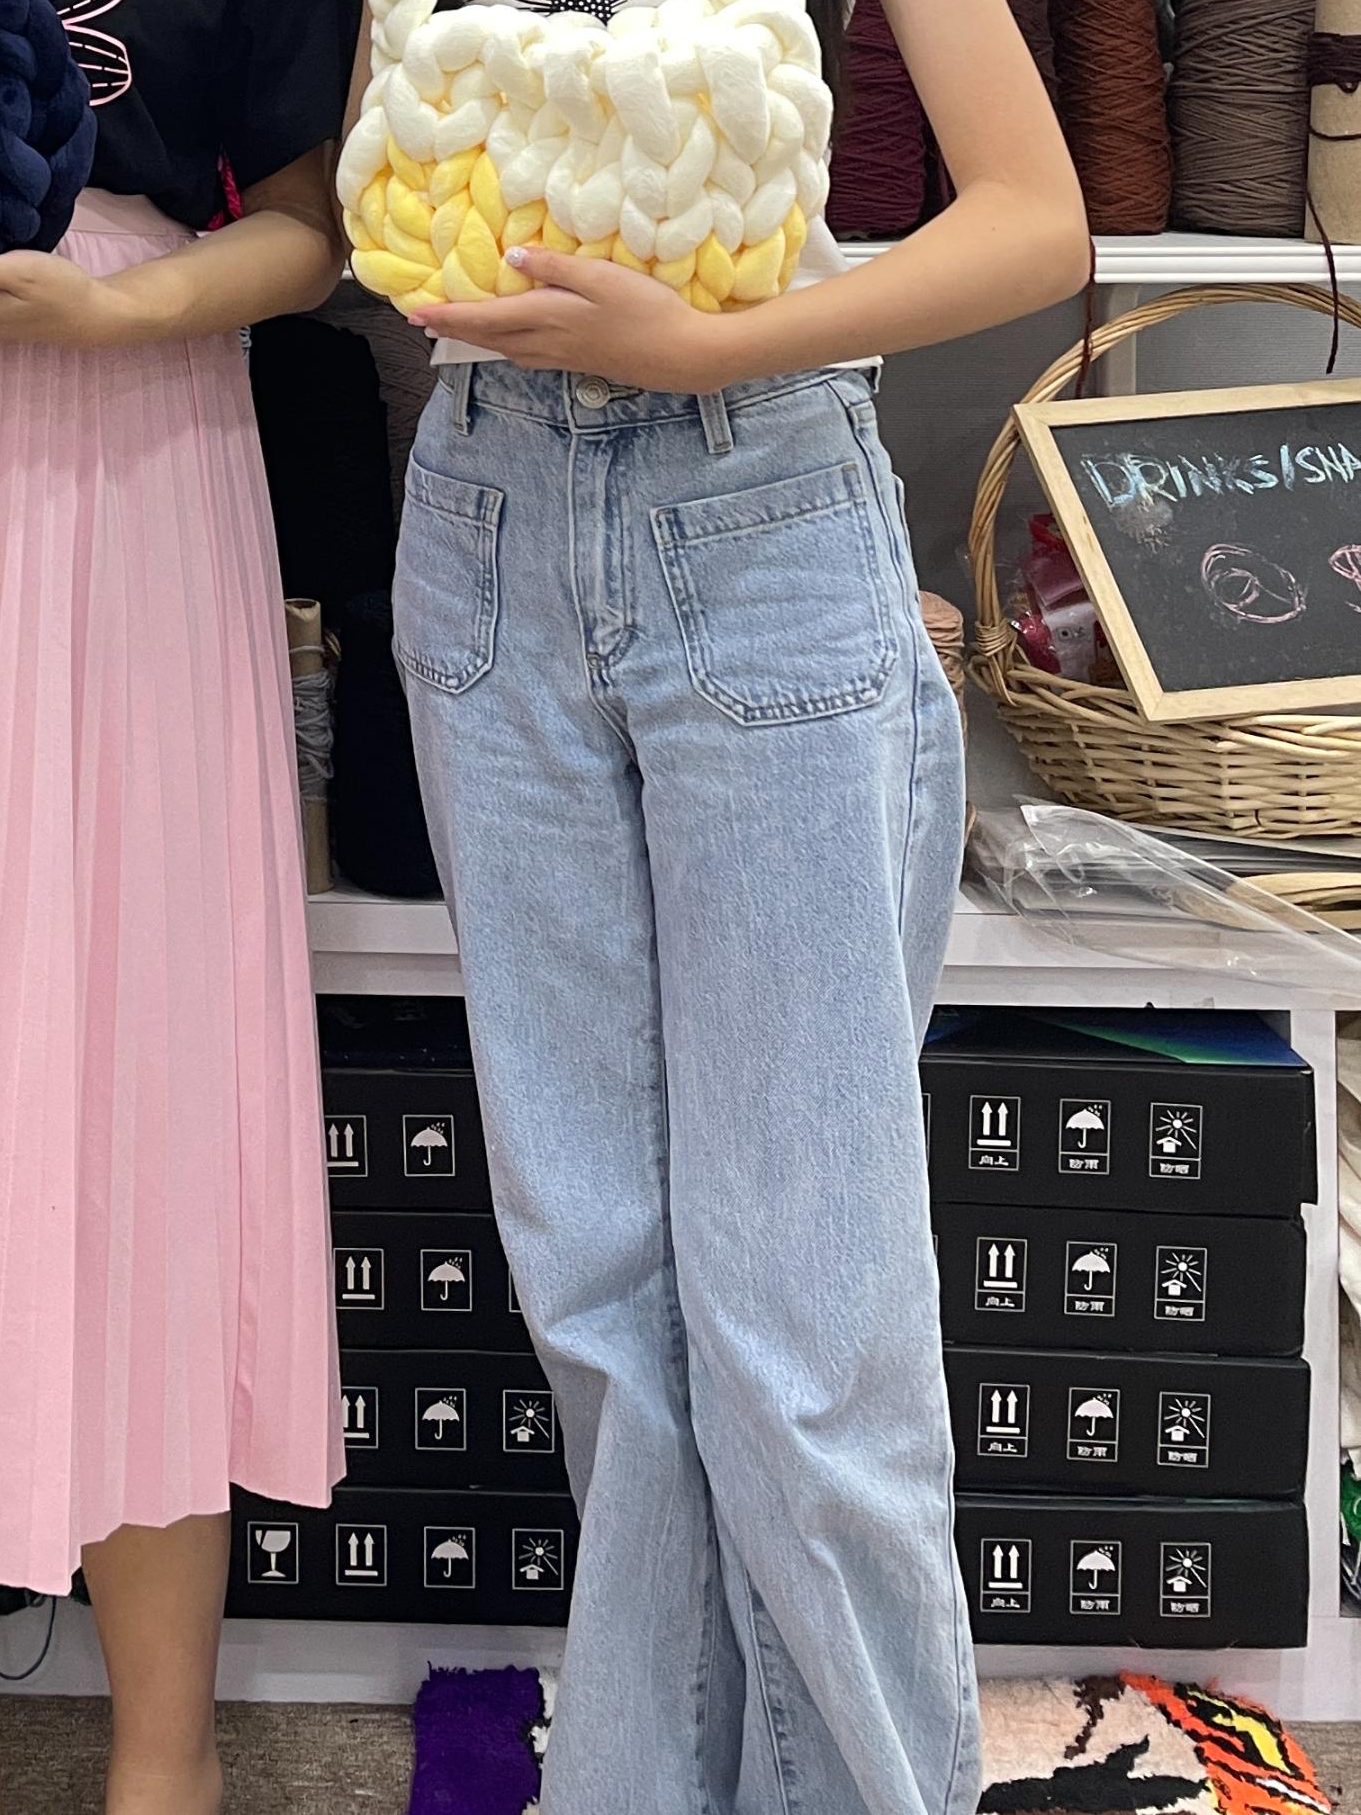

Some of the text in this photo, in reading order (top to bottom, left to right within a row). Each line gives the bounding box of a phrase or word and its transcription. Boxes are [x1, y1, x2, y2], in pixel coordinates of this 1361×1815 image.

[979, 1155, 1009, 1167] 向上
[985, 1296, 1015, 1308] 向上
[988, 1442, 1018, 1453] 向上
[990, 1597, 1021, 1608] 向上
